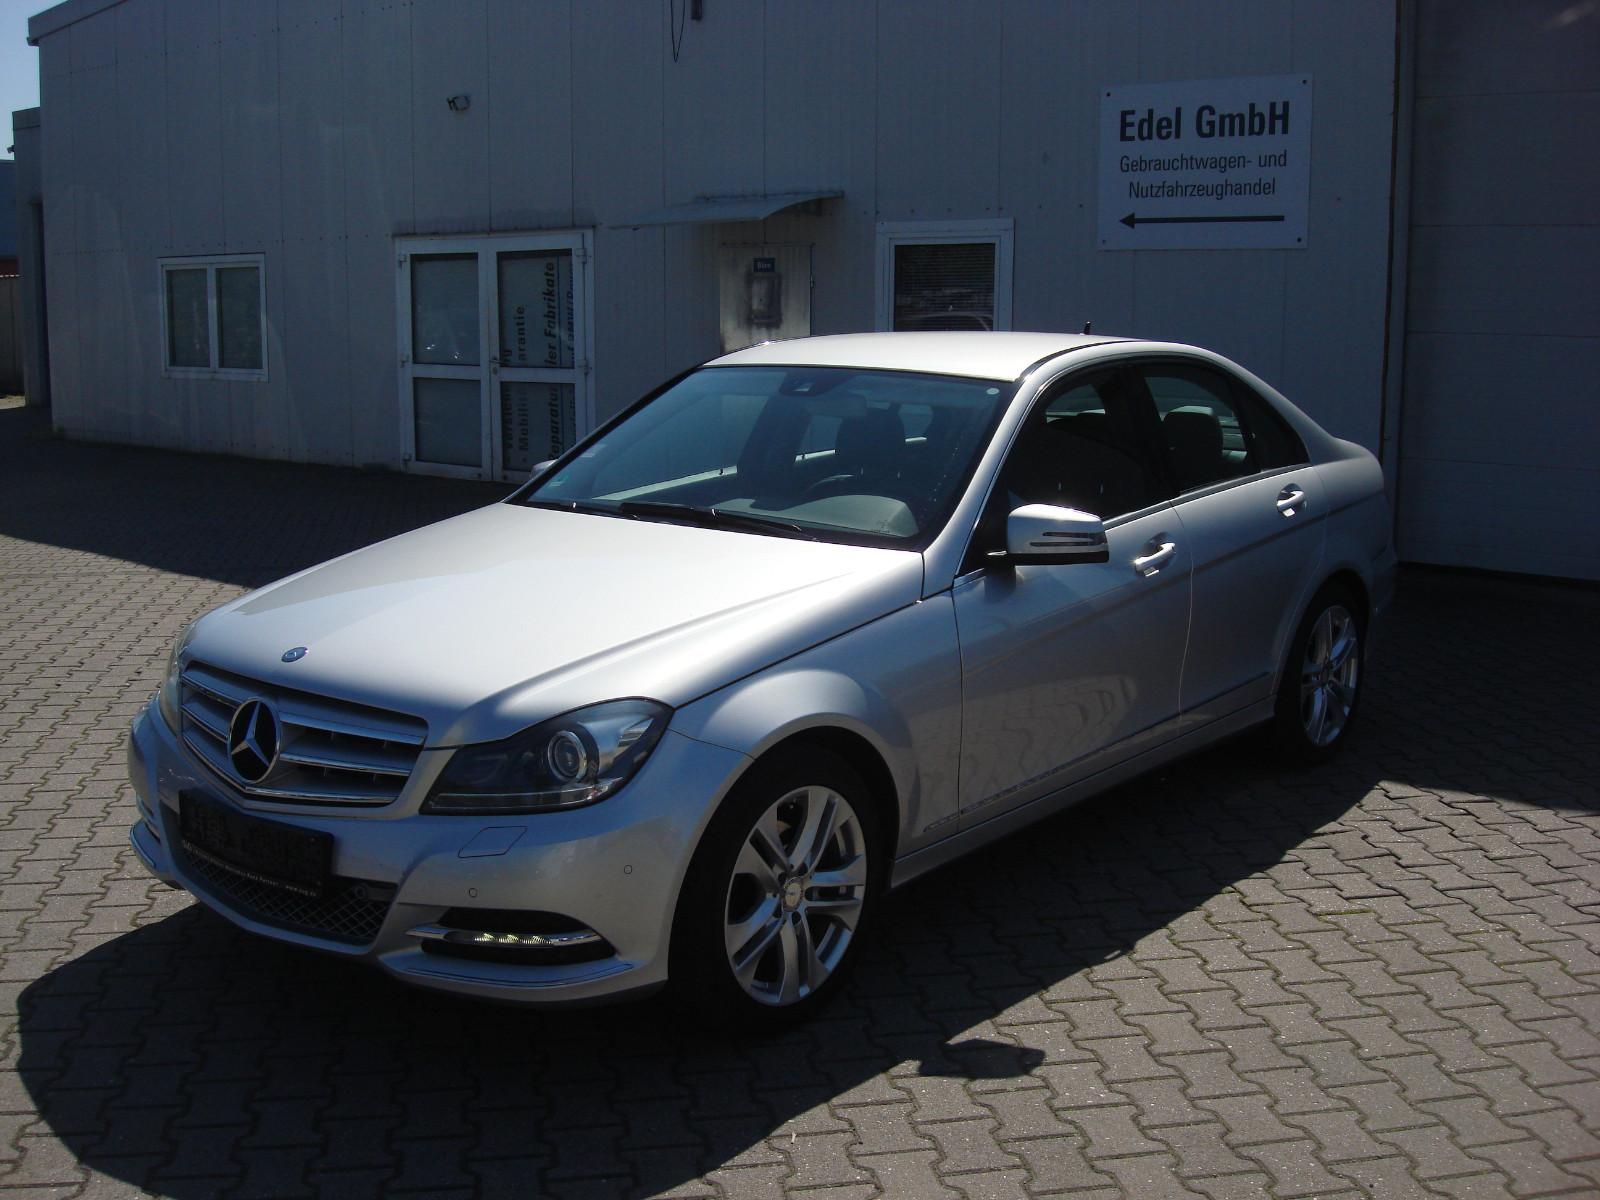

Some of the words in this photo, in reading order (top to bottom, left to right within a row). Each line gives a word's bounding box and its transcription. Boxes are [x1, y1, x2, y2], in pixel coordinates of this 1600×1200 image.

[1119, 106, 1182, 142] Edel
[1195, 101, 1290, 138] GmbH
[1119, 153, 1252, 173] Gebrauchtwagen-
[1258, 149, 1288, 169] und
[1129, 177, 1276, 200] Nutzfahrzeughandel
[541, 262, 557, 339] Fabrikate
